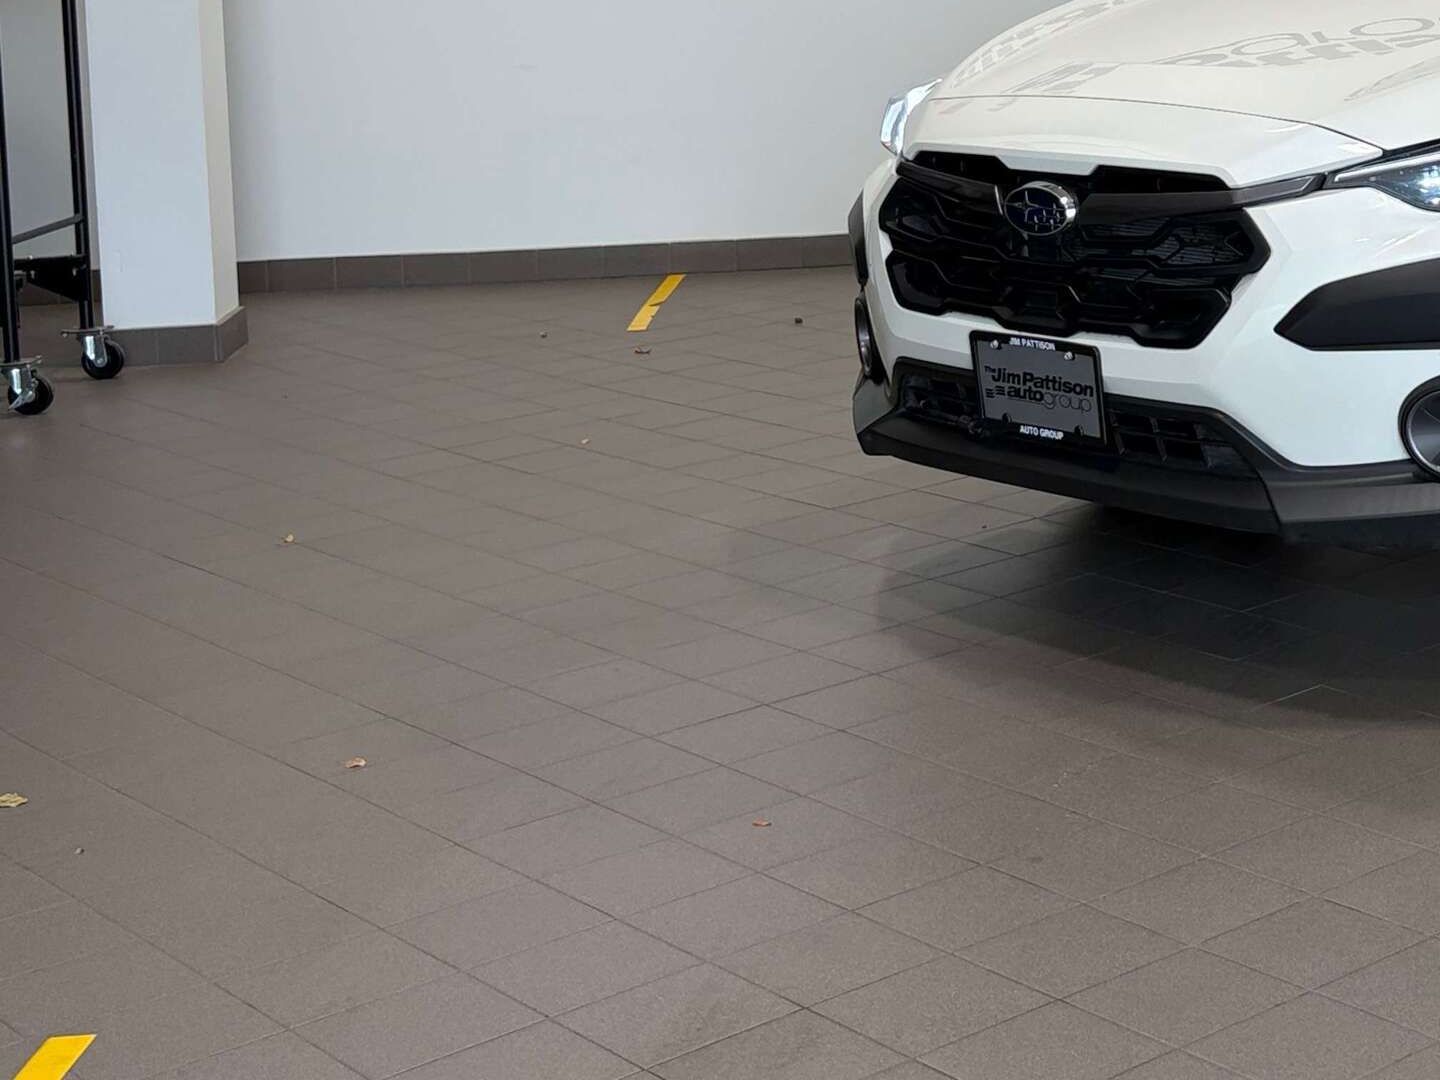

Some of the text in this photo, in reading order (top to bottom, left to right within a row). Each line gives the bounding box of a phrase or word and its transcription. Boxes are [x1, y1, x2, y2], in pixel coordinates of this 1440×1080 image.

[1021, 338, 1056, 351] PATTISON
[1019, 425, 1064, 440] AUTO GROUP
